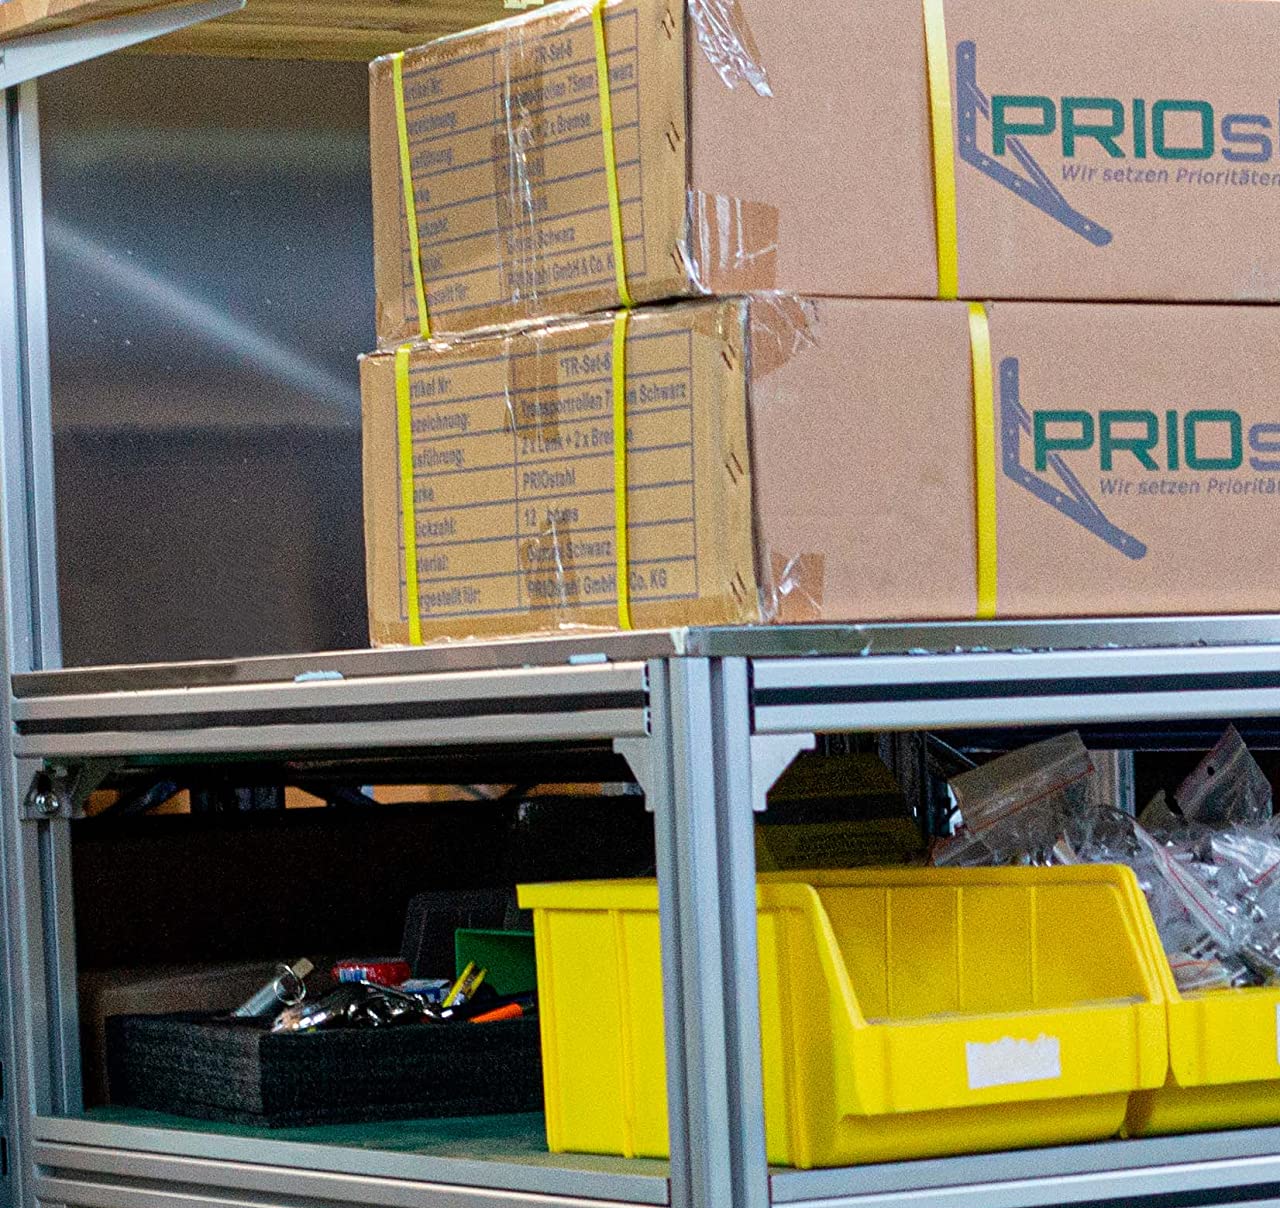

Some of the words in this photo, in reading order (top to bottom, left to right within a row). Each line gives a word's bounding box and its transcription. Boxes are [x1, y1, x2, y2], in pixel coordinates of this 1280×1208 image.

[1061, 163, 1097, 184] Wir
[1102, 166, 1169, 186] setzen
[640, 383, 686, 404] Schwarz
[1100, 477, 1132, 496] Wir
[1138, 480, 1200, 496] setzen
